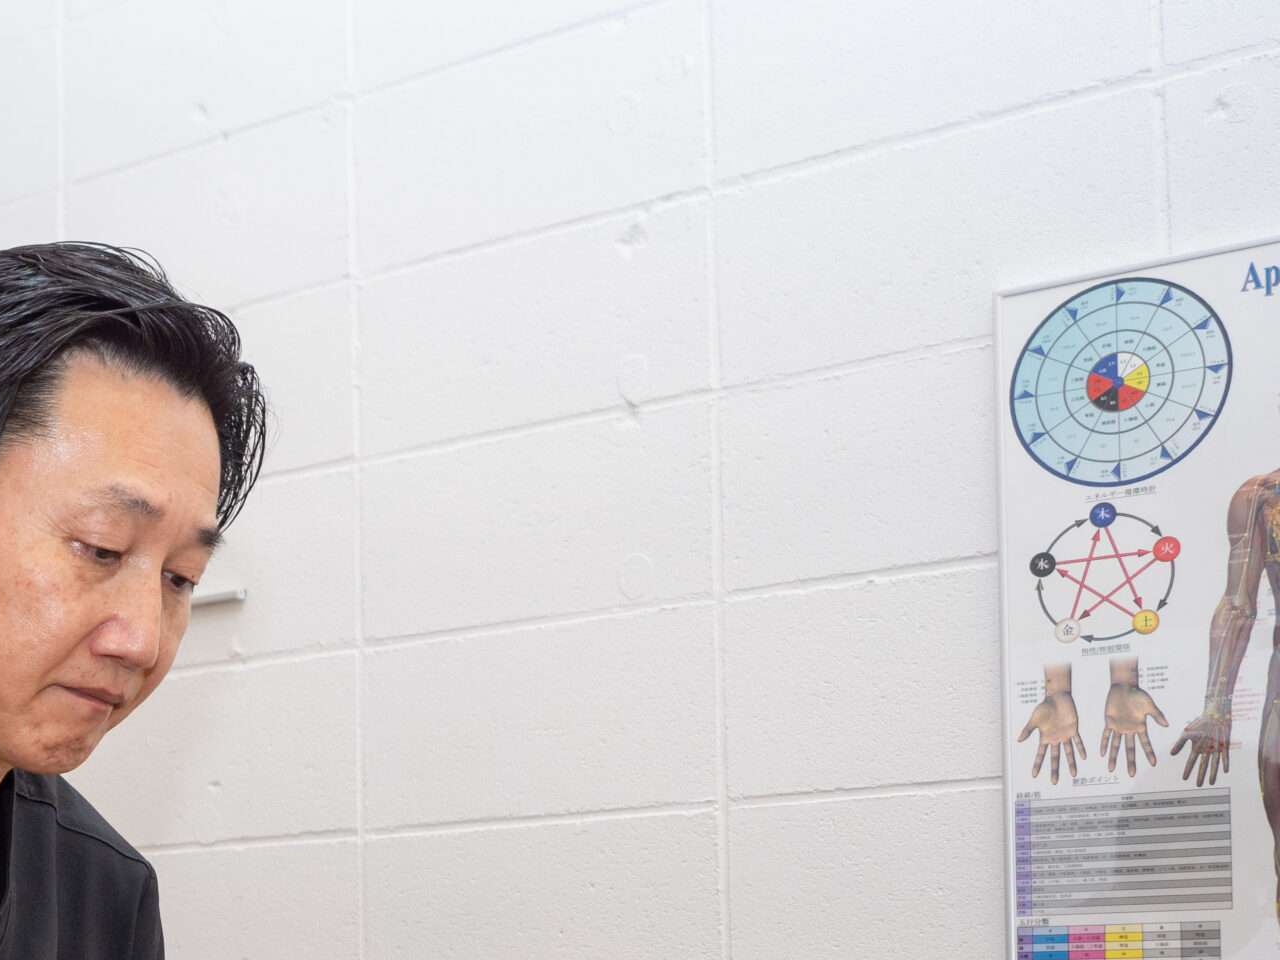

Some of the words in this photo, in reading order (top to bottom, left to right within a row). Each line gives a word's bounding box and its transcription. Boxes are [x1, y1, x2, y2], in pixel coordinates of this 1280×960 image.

[1240, 261, 1280, 296] Ap
[1097, 508, 1111, 520] 木
[1161, 542, 1174, 555] 火
[1035, 557, 1049, 571] 水
[1140, 615, 1153, 628] 土
[1062, 623, 1075, 637] 金
